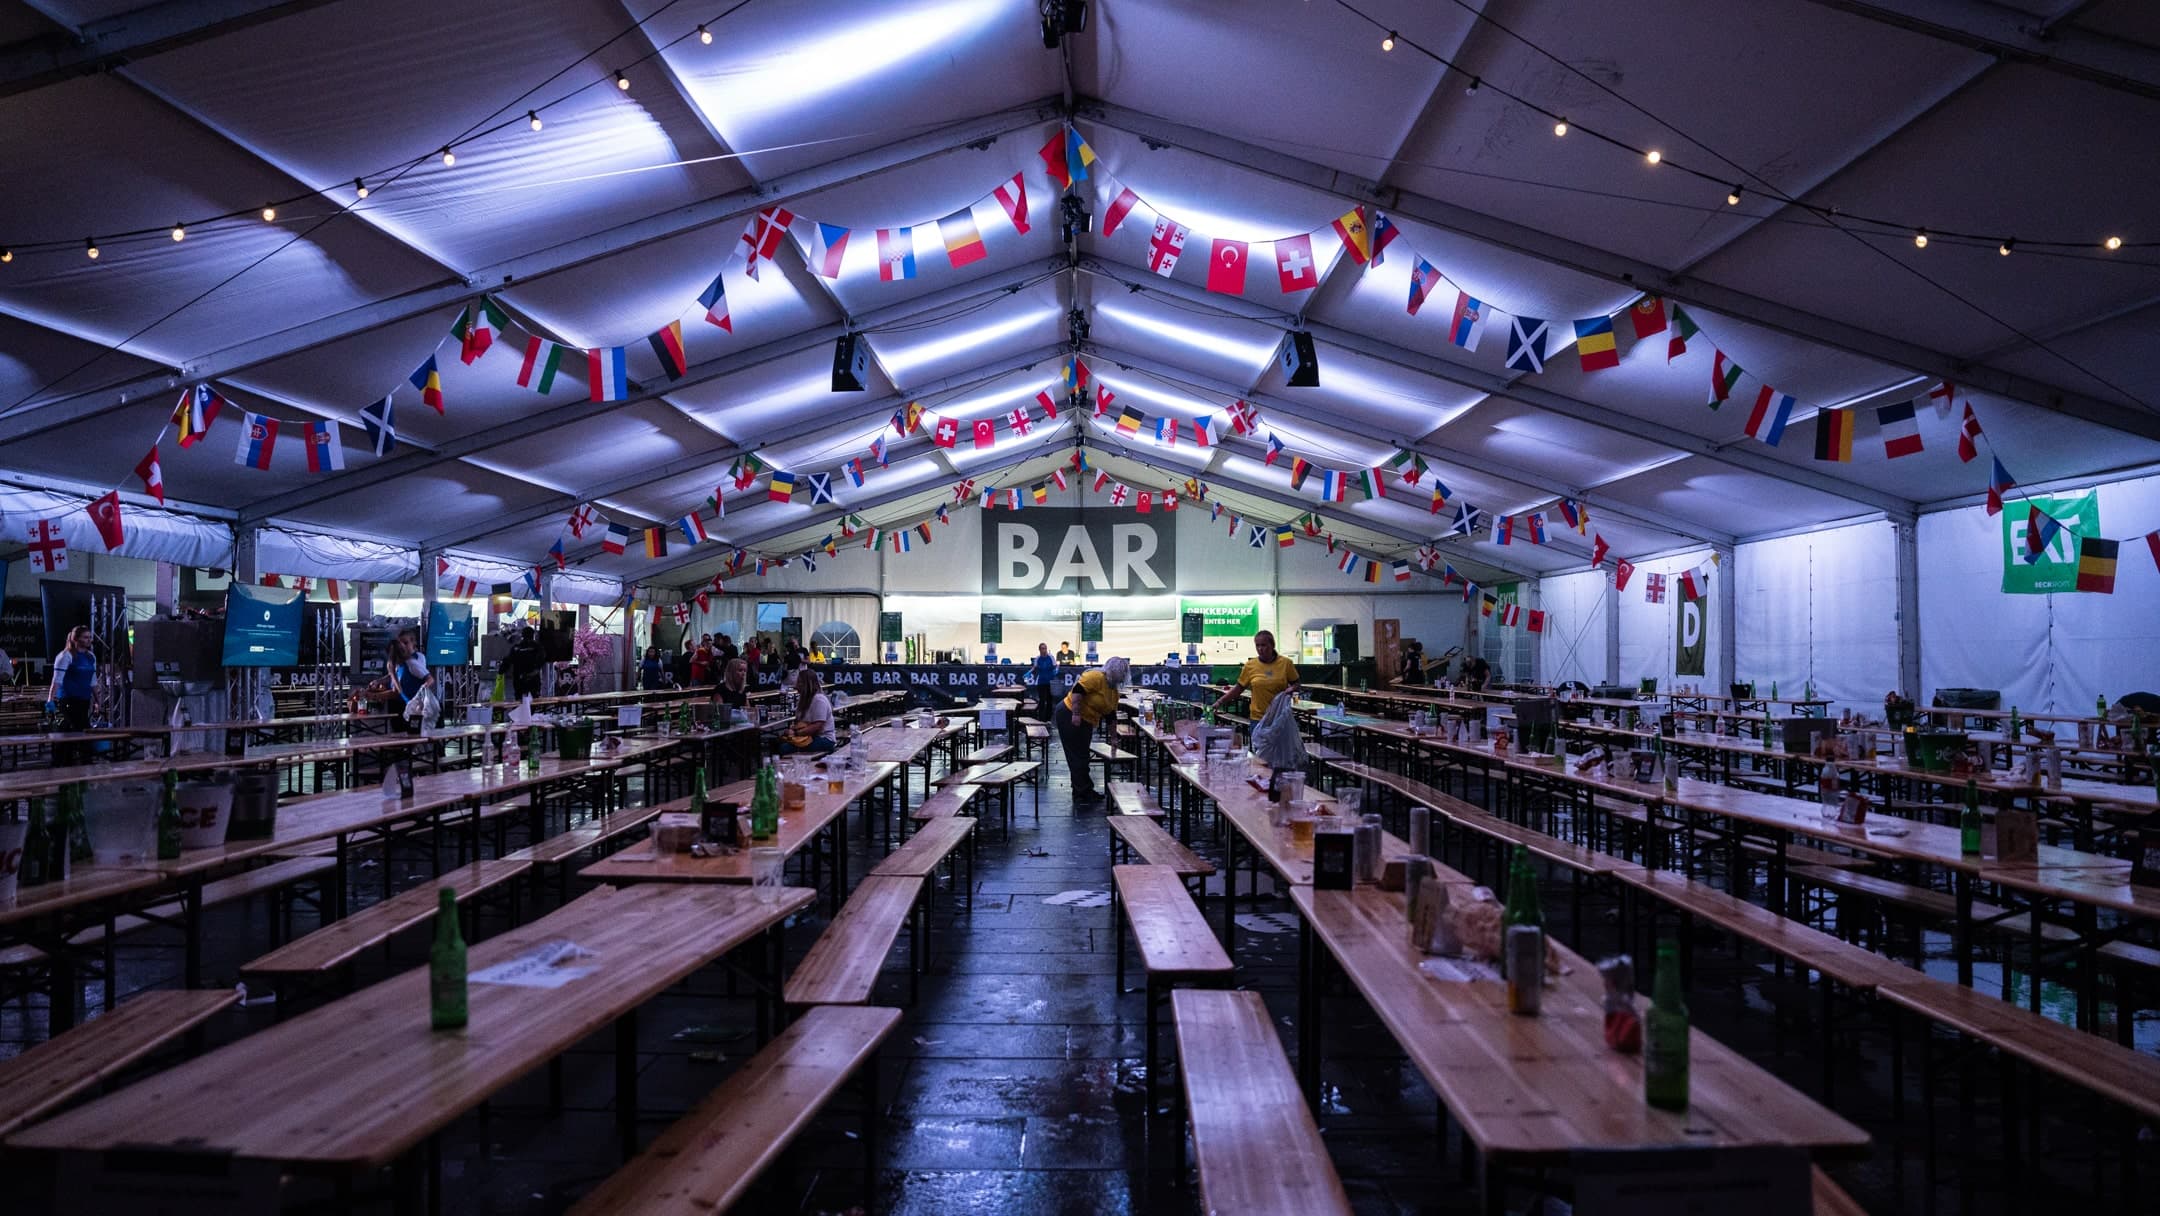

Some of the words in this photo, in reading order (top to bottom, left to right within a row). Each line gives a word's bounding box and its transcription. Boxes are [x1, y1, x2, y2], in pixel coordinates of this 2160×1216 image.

[997, 522, 1168, 592] BAR
[1186, 607, 1253, 616] DRIKKEPAKKE
[1682, 601, 1700, 648] D
[759, 671, 779, 685] BA
[834, 672, 863, 685] BAR
[872, 672, 901, 685] BAR
[910, 672, 940, 685] BAR
[949, 672, 978, 686] BAR
[987, 673, 1017, 686] BAR
[1142, 673, 1171, 686] BAR
[1180, 673, 1209, 686] BAR
[178, 805, 218, 829] CE
